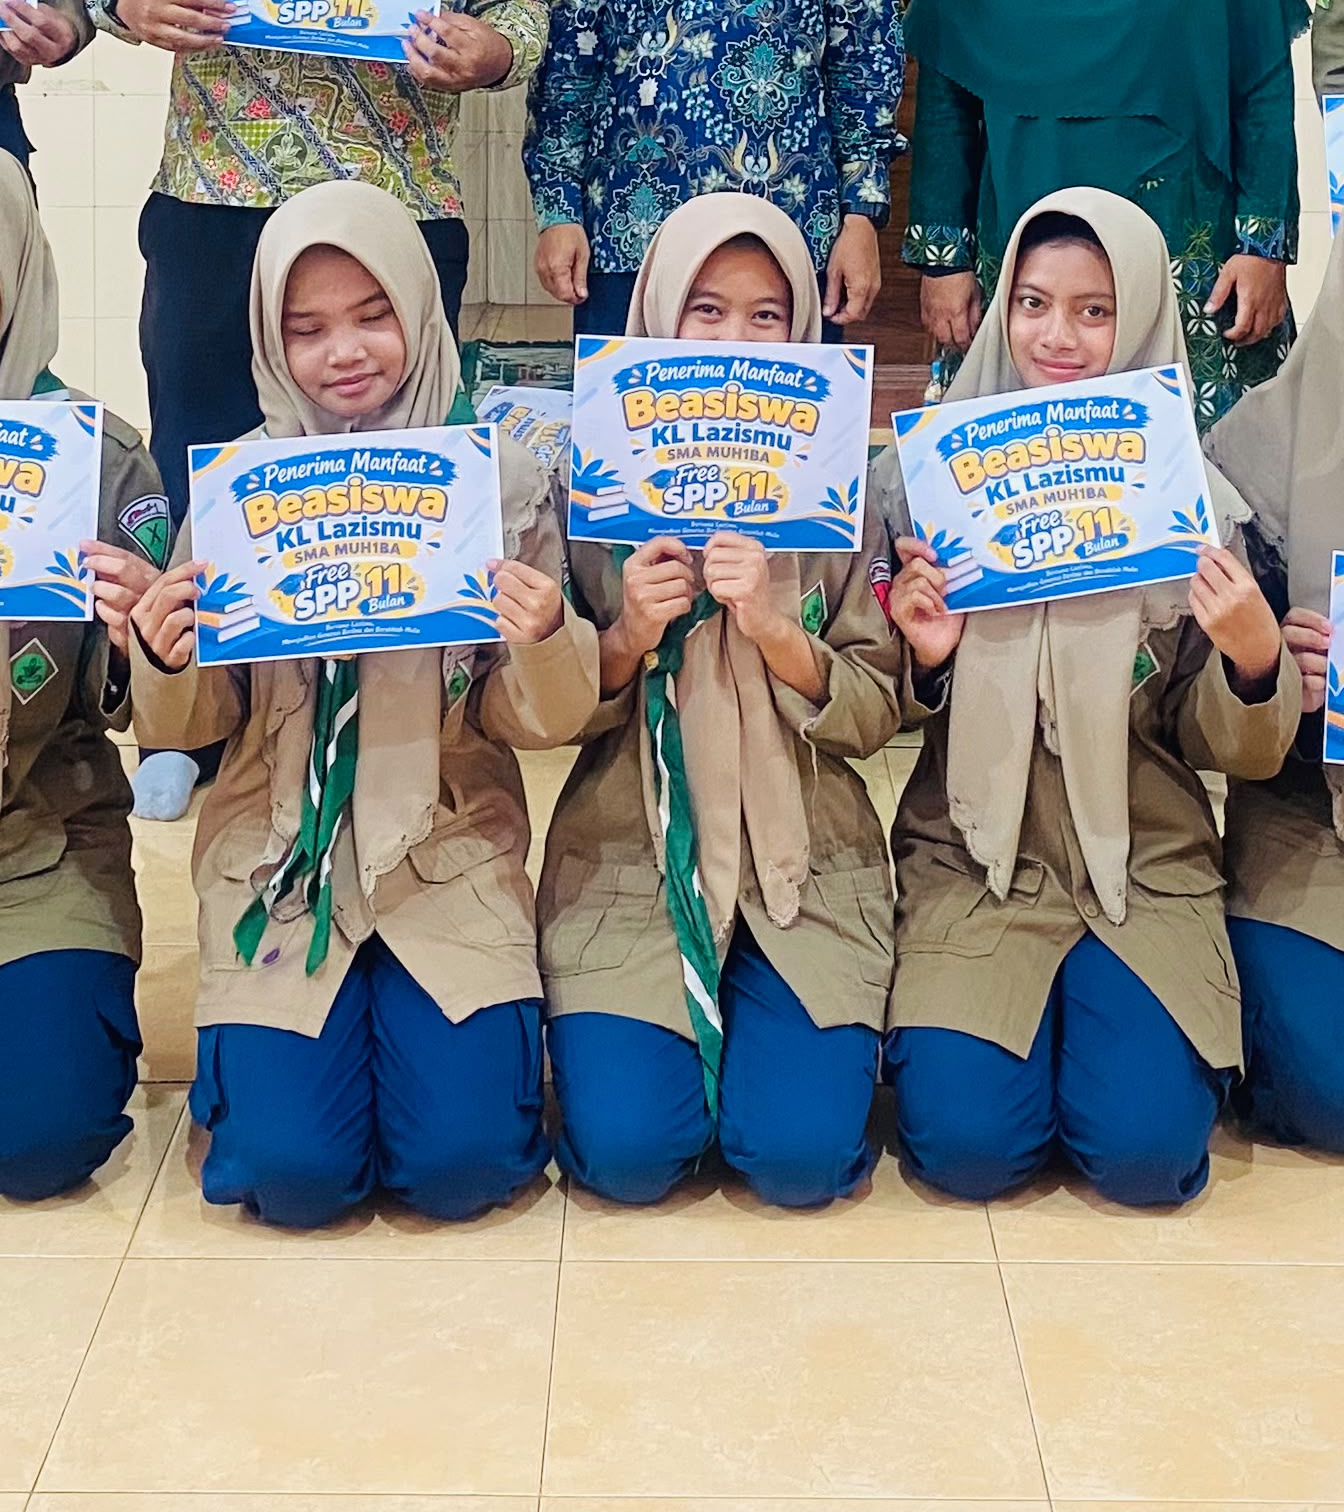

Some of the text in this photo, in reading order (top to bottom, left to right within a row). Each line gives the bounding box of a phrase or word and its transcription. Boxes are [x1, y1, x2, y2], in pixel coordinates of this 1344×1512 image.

[278, 0, 330, 24] SPP
[333, 17, 362, 28] Bulan
[645, 360, 803, 387] Penerima Manfaat
[622, 384, 820, 435] Beasiswa
[964, 400, 1120, 445] Penerima Manfaat
[652, 423, 792, 451] KL Lazismu
[667, 447, 700, 461] SMA
[949, 428, 1146, 495] Beasiswa
[264, 452, 427, 488] Penerima Manfaat
[676, 463, 719, 483] Free
[662, 471, 770, 515] SPP 11
[985, 465, 1125, 506] KL Lazismu
[242, 477, 447, 538] Beasiswa
[733, 500, 770, 516] Bulan
[1006, 498, 1039, 515] SMA
[276, 516, 421, 553] KL Lazismu
[1018, 510, 1062, 536] Free
[1011, 507, 1114, 570] SPP 11
[1082, 536, 1120, 558] Bulan
[294, 547, 330, 564] SMA
[305, 563, 350, 589] Free
[294, 563, 402, 620] SPP 11
[367, 593, 406, 614] Bulan
